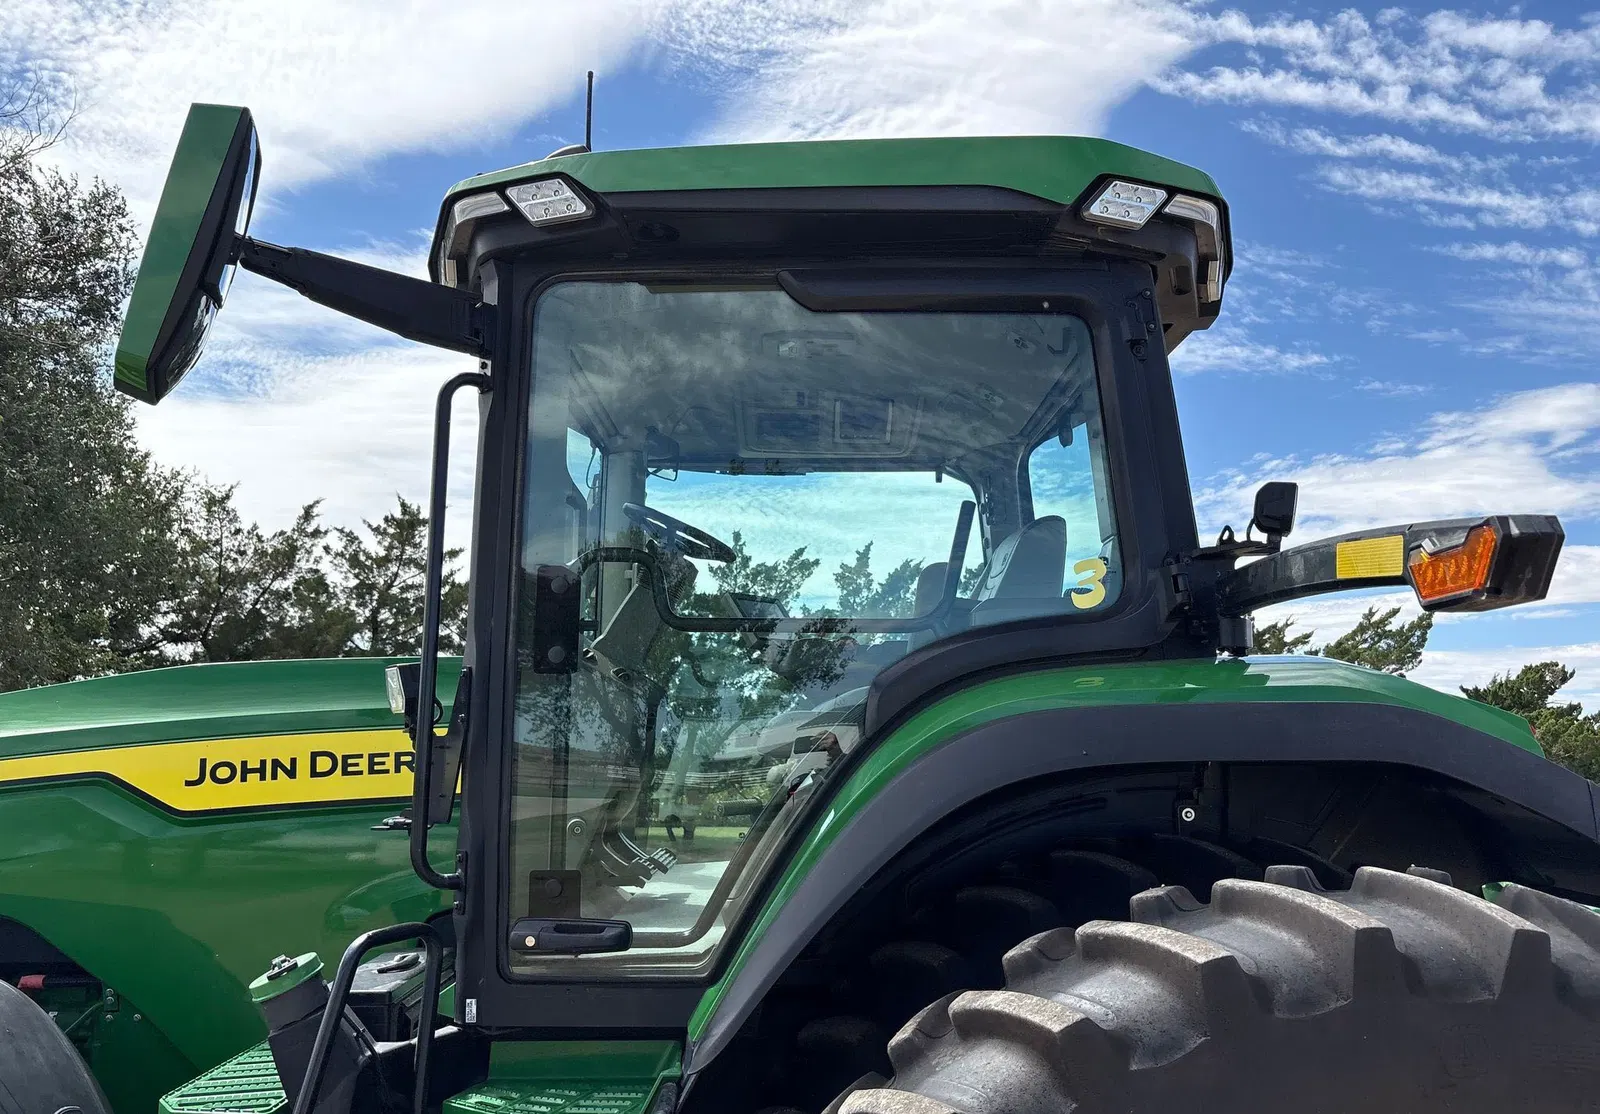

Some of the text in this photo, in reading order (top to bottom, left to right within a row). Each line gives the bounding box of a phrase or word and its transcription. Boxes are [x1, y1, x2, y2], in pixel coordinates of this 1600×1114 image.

[1071, 557, 1107, 609] 3
[184, 751, 415, 787] JOHN DEER
